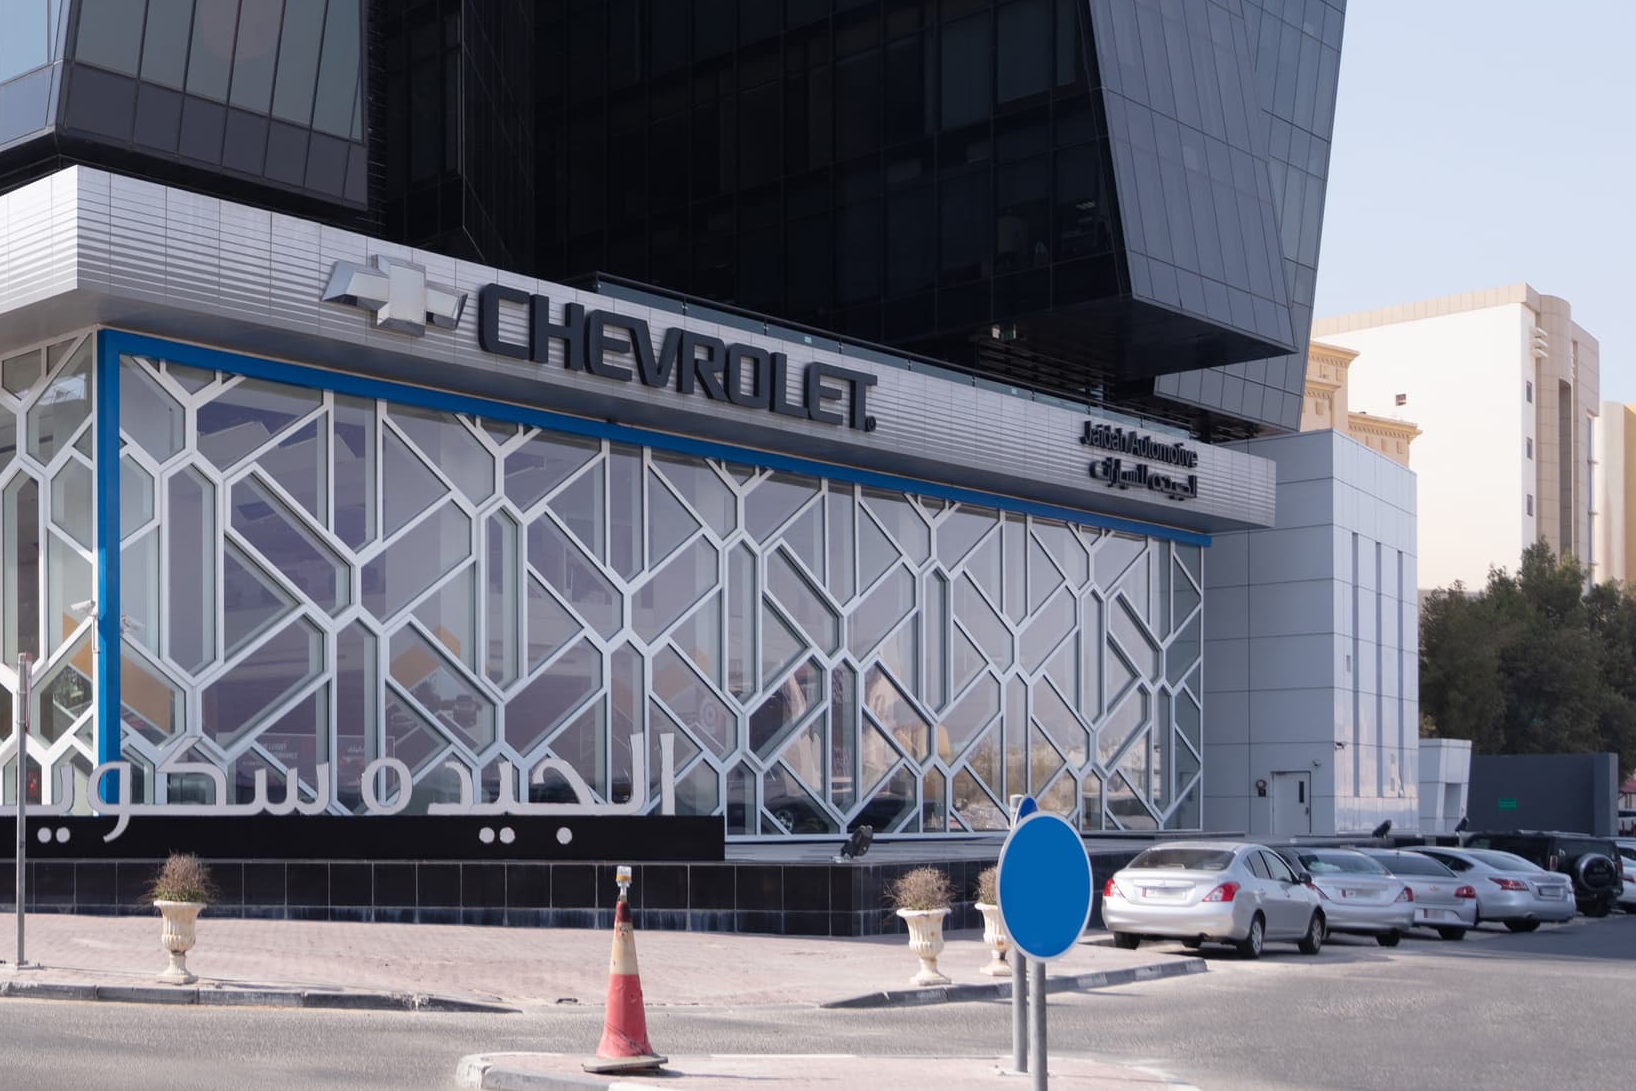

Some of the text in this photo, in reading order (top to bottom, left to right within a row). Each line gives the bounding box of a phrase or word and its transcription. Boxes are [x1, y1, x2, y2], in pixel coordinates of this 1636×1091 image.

[477, 283, 878, 432] CHEVROLET
[1079, 421, 1198, 468] Jaidah Automotive
[360, 731, 676, 845] الجيده
